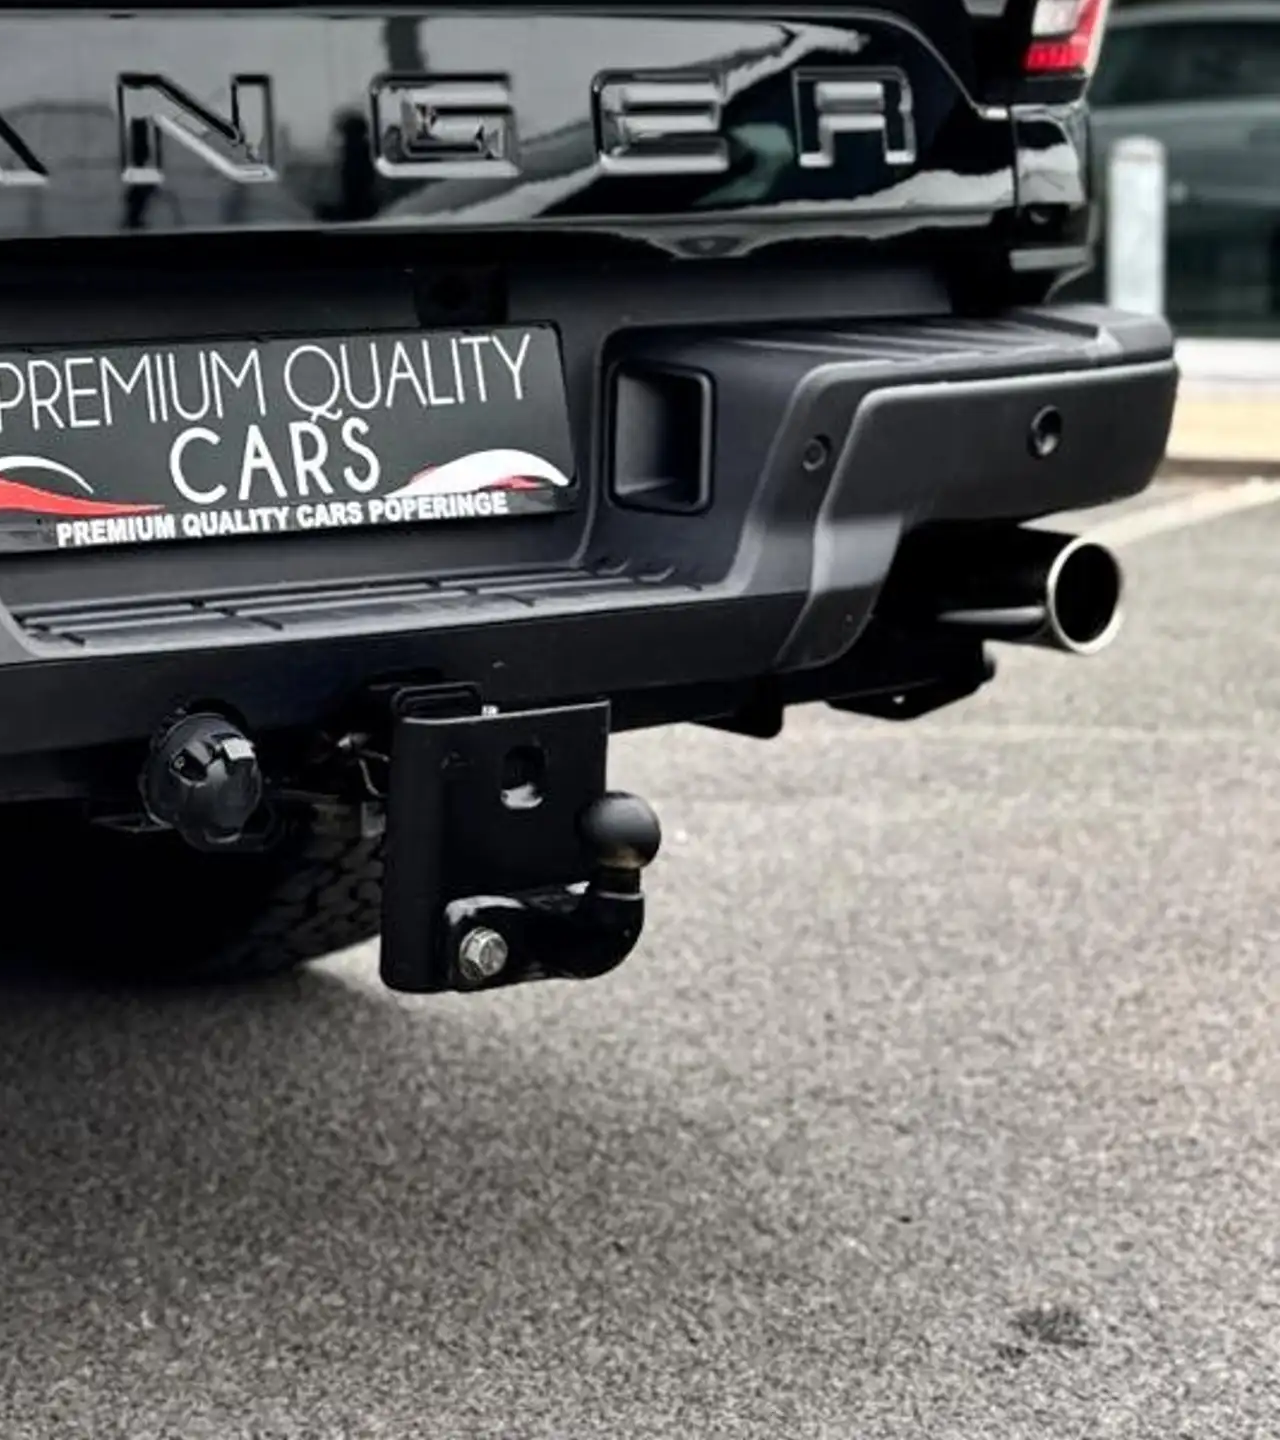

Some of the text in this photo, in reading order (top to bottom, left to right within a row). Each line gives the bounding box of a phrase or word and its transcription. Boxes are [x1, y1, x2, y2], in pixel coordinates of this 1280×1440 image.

[284, 333, 531, 423] QUALITY
[169, 416, 382, 505] CARS
[55, 492, 510, 548] PREMIUM QUALITY CARS POPERINGE
